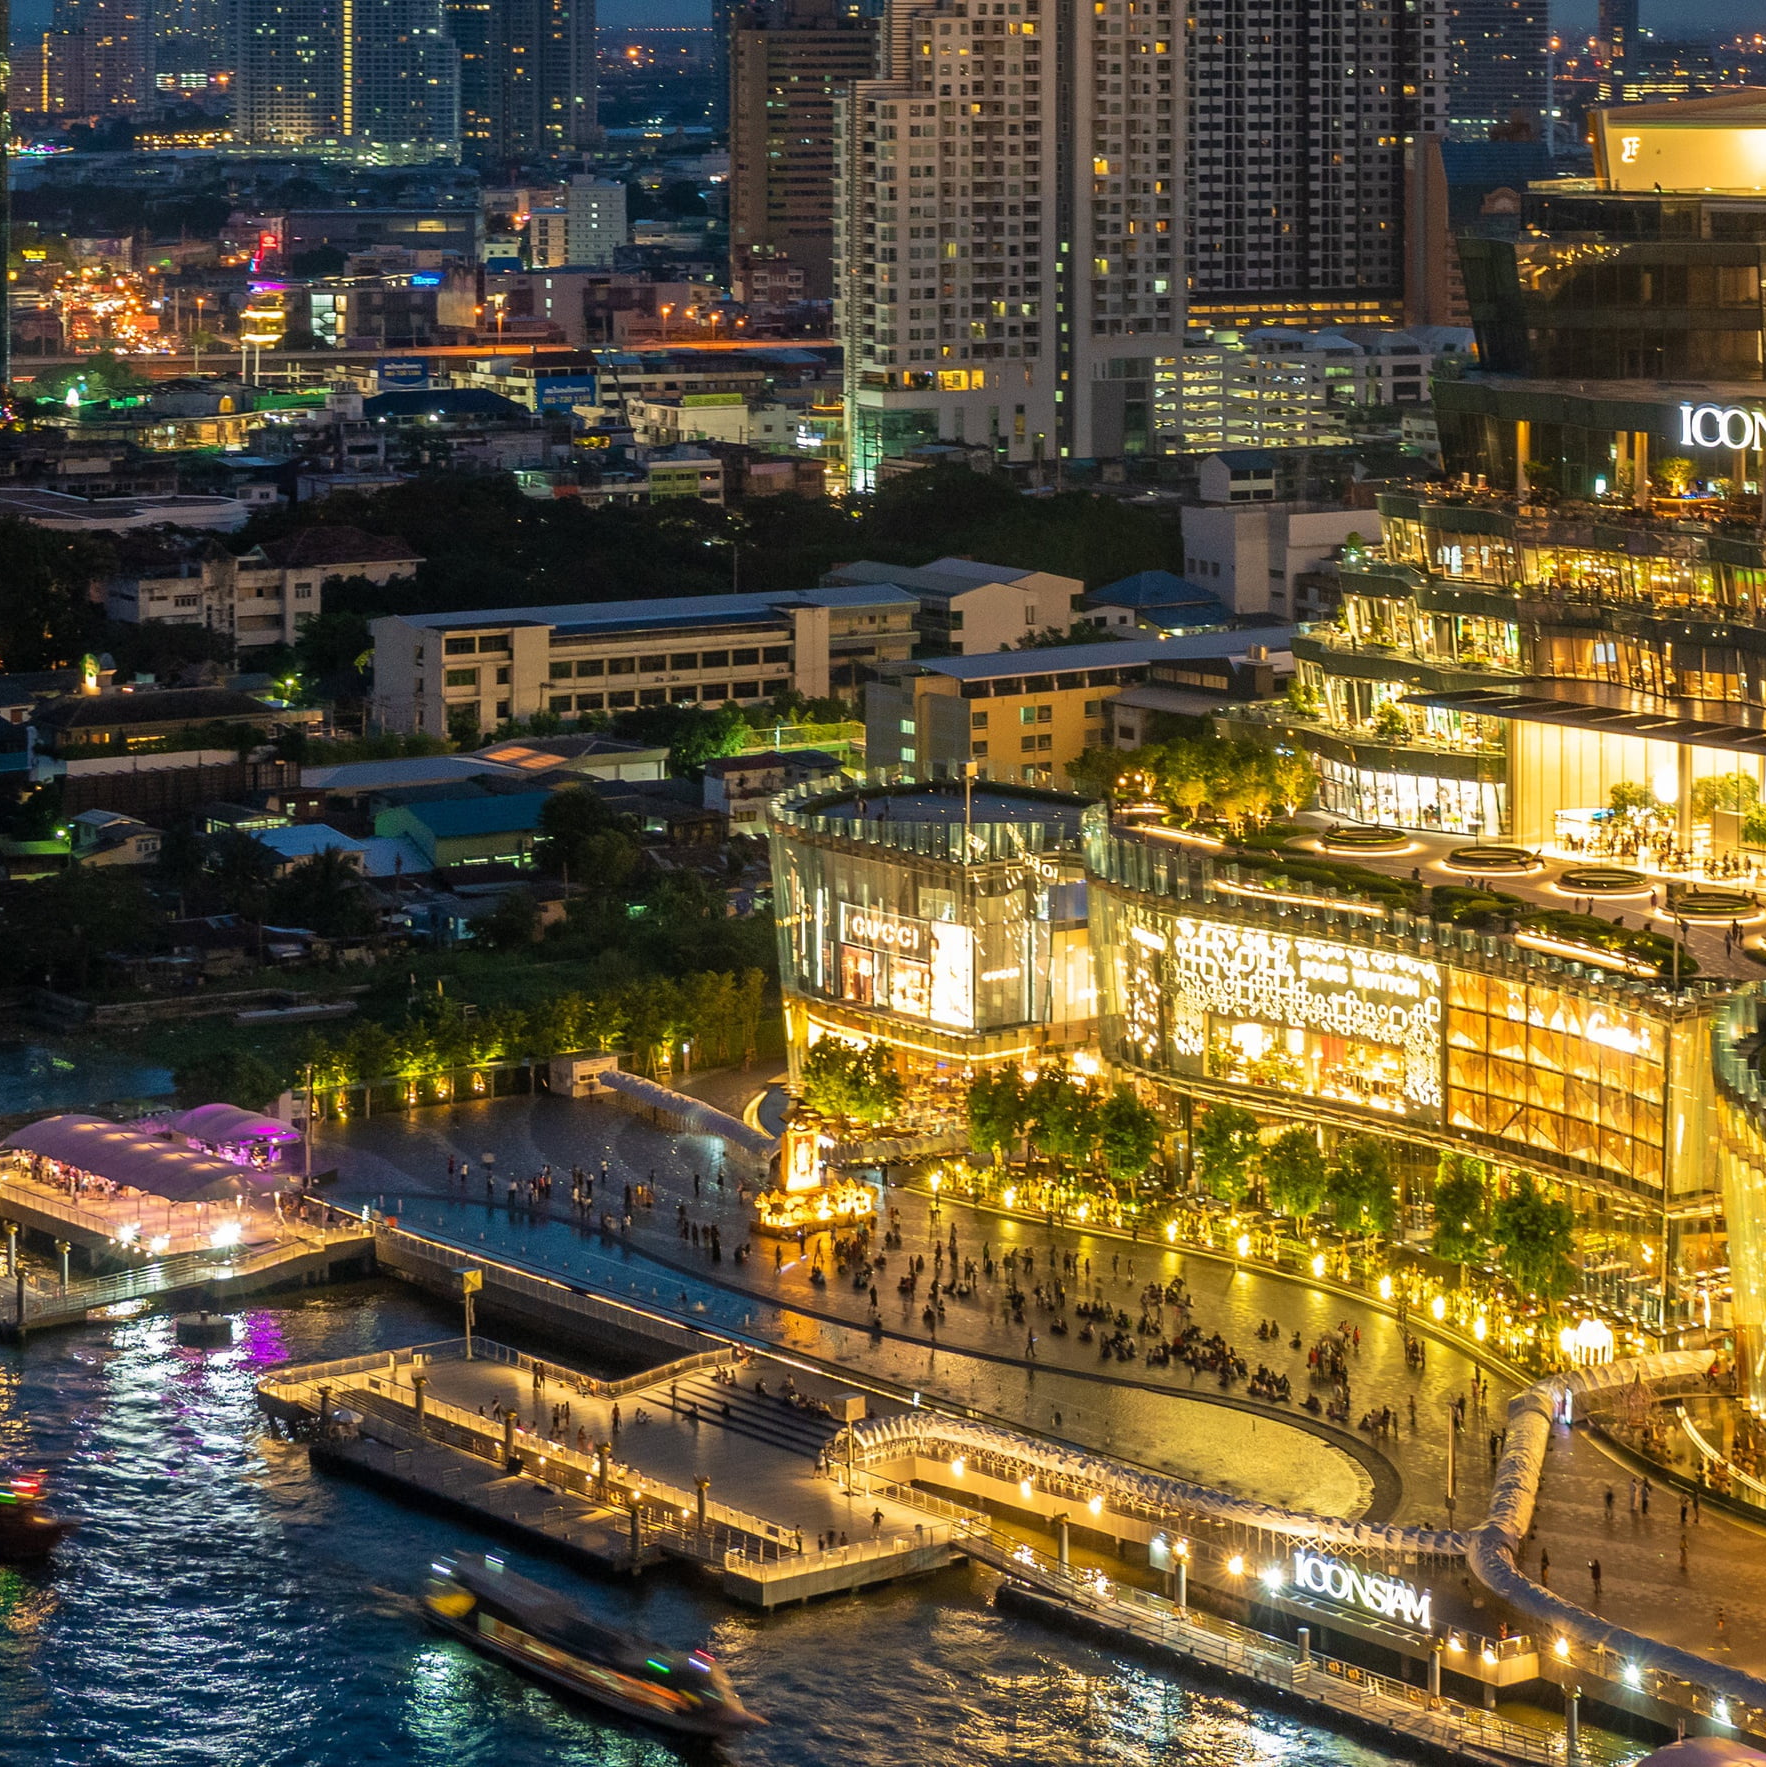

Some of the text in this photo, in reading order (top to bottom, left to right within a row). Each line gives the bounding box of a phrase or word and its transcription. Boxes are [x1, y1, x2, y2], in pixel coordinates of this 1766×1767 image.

[852, 915, 920, 950] GUCCI
[1300, 959, 1421, 999] LOUIS VUITTON
[1293, 1552, 1432, 1630] ICONSIAM
